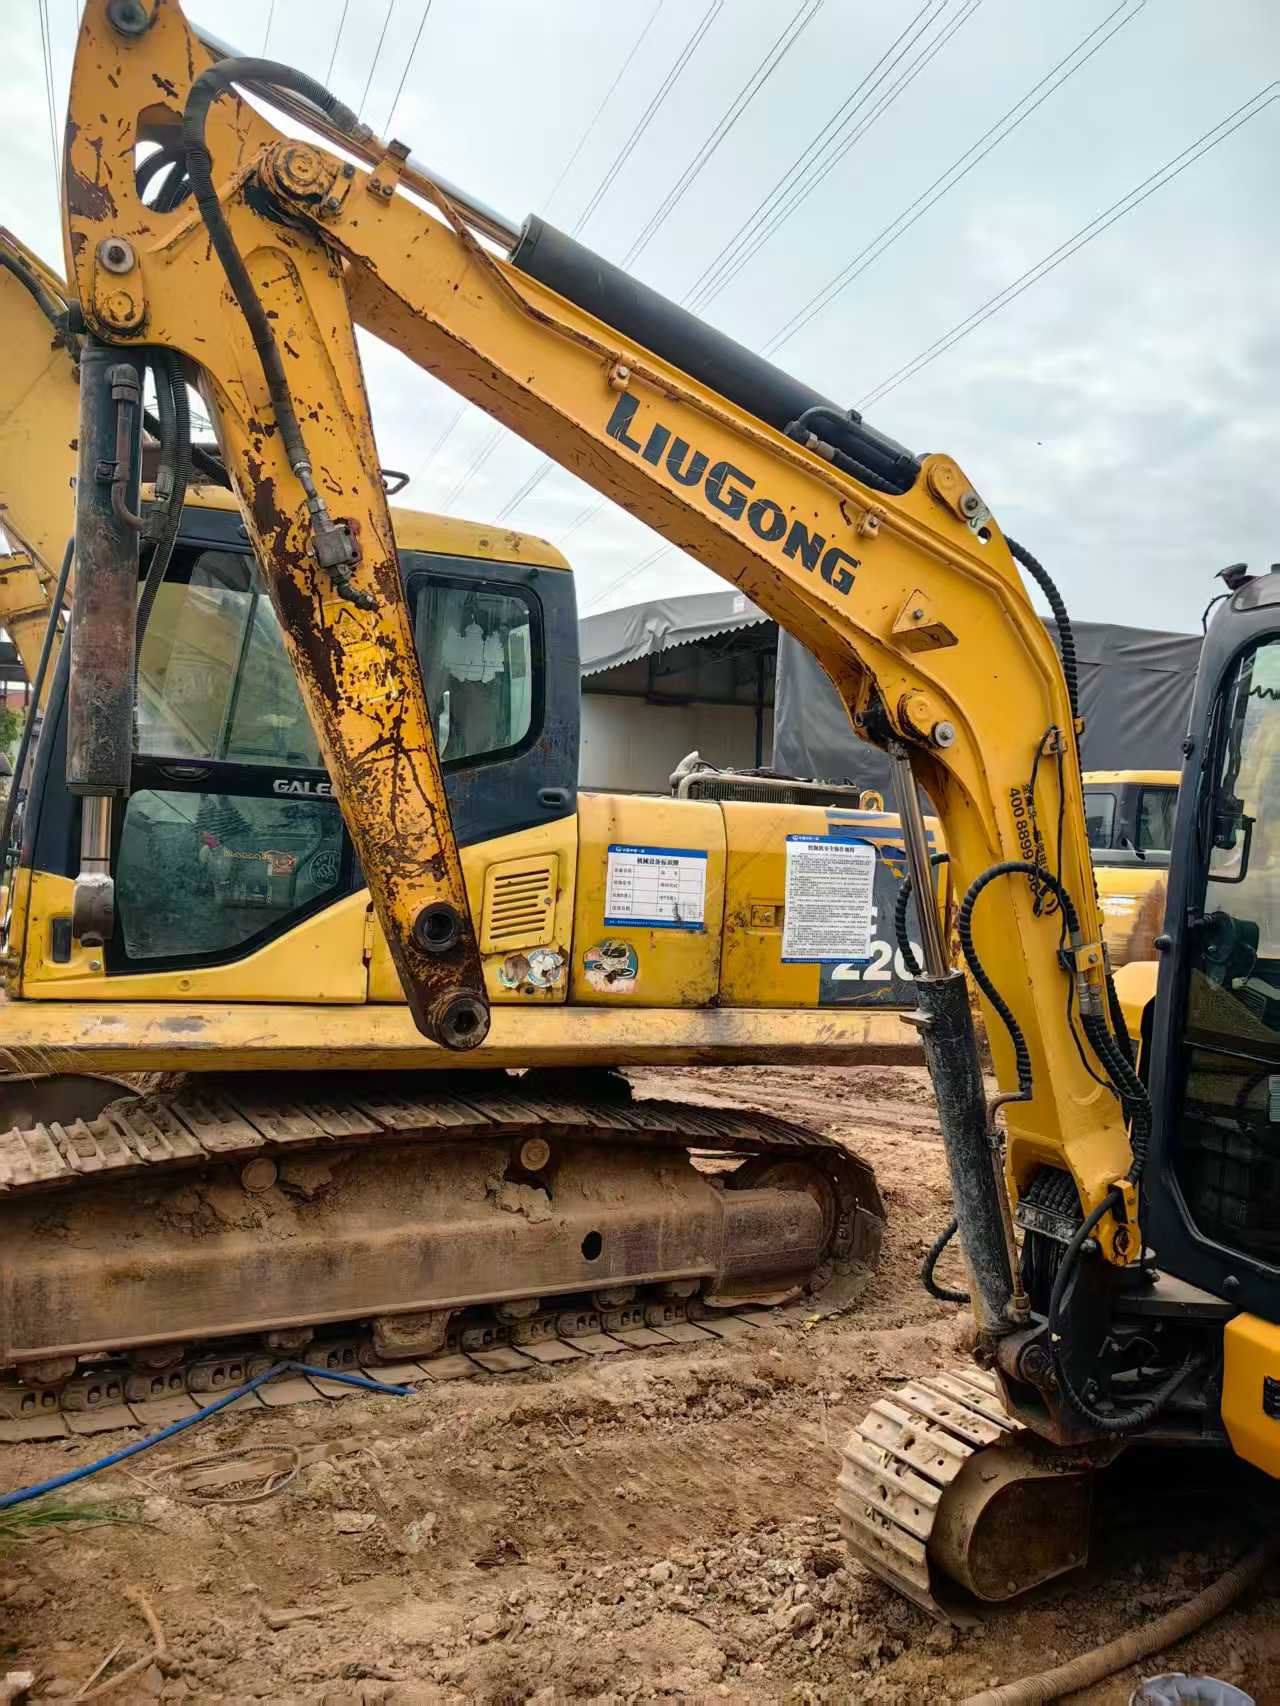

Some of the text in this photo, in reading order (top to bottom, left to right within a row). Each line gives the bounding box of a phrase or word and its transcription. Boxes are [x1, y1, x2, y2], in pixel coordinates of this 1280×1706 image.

[606, 392, 860, 595] LIUGONG
[1009, 787, 1025, 817] 400
[1016, 820, 1034, 860] 8899
